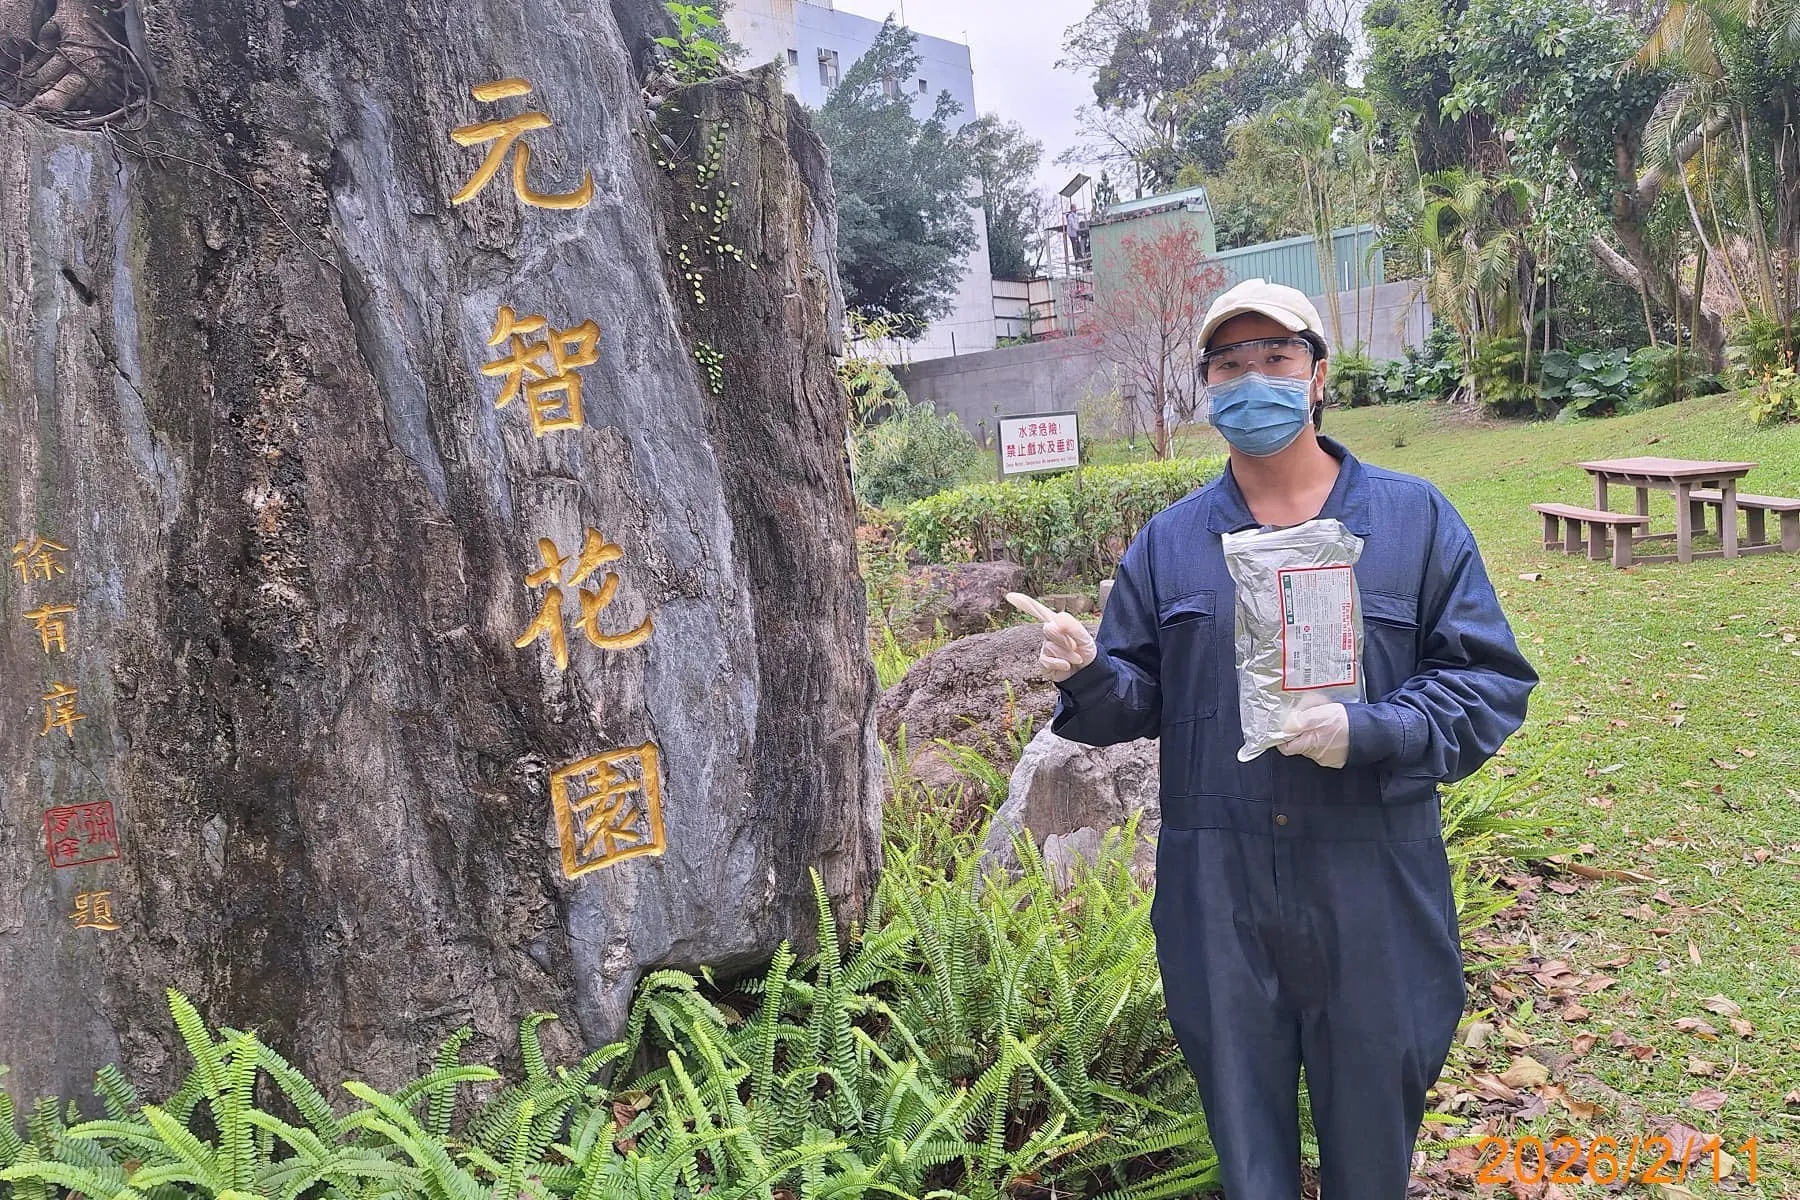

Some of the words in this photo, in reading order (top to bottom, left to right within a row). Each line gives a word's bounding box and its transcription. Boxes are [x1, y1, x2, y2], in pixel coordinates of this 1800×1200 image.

[451, 78, 665, 879] 元智花園
[67, 889, 121, 931] 題
